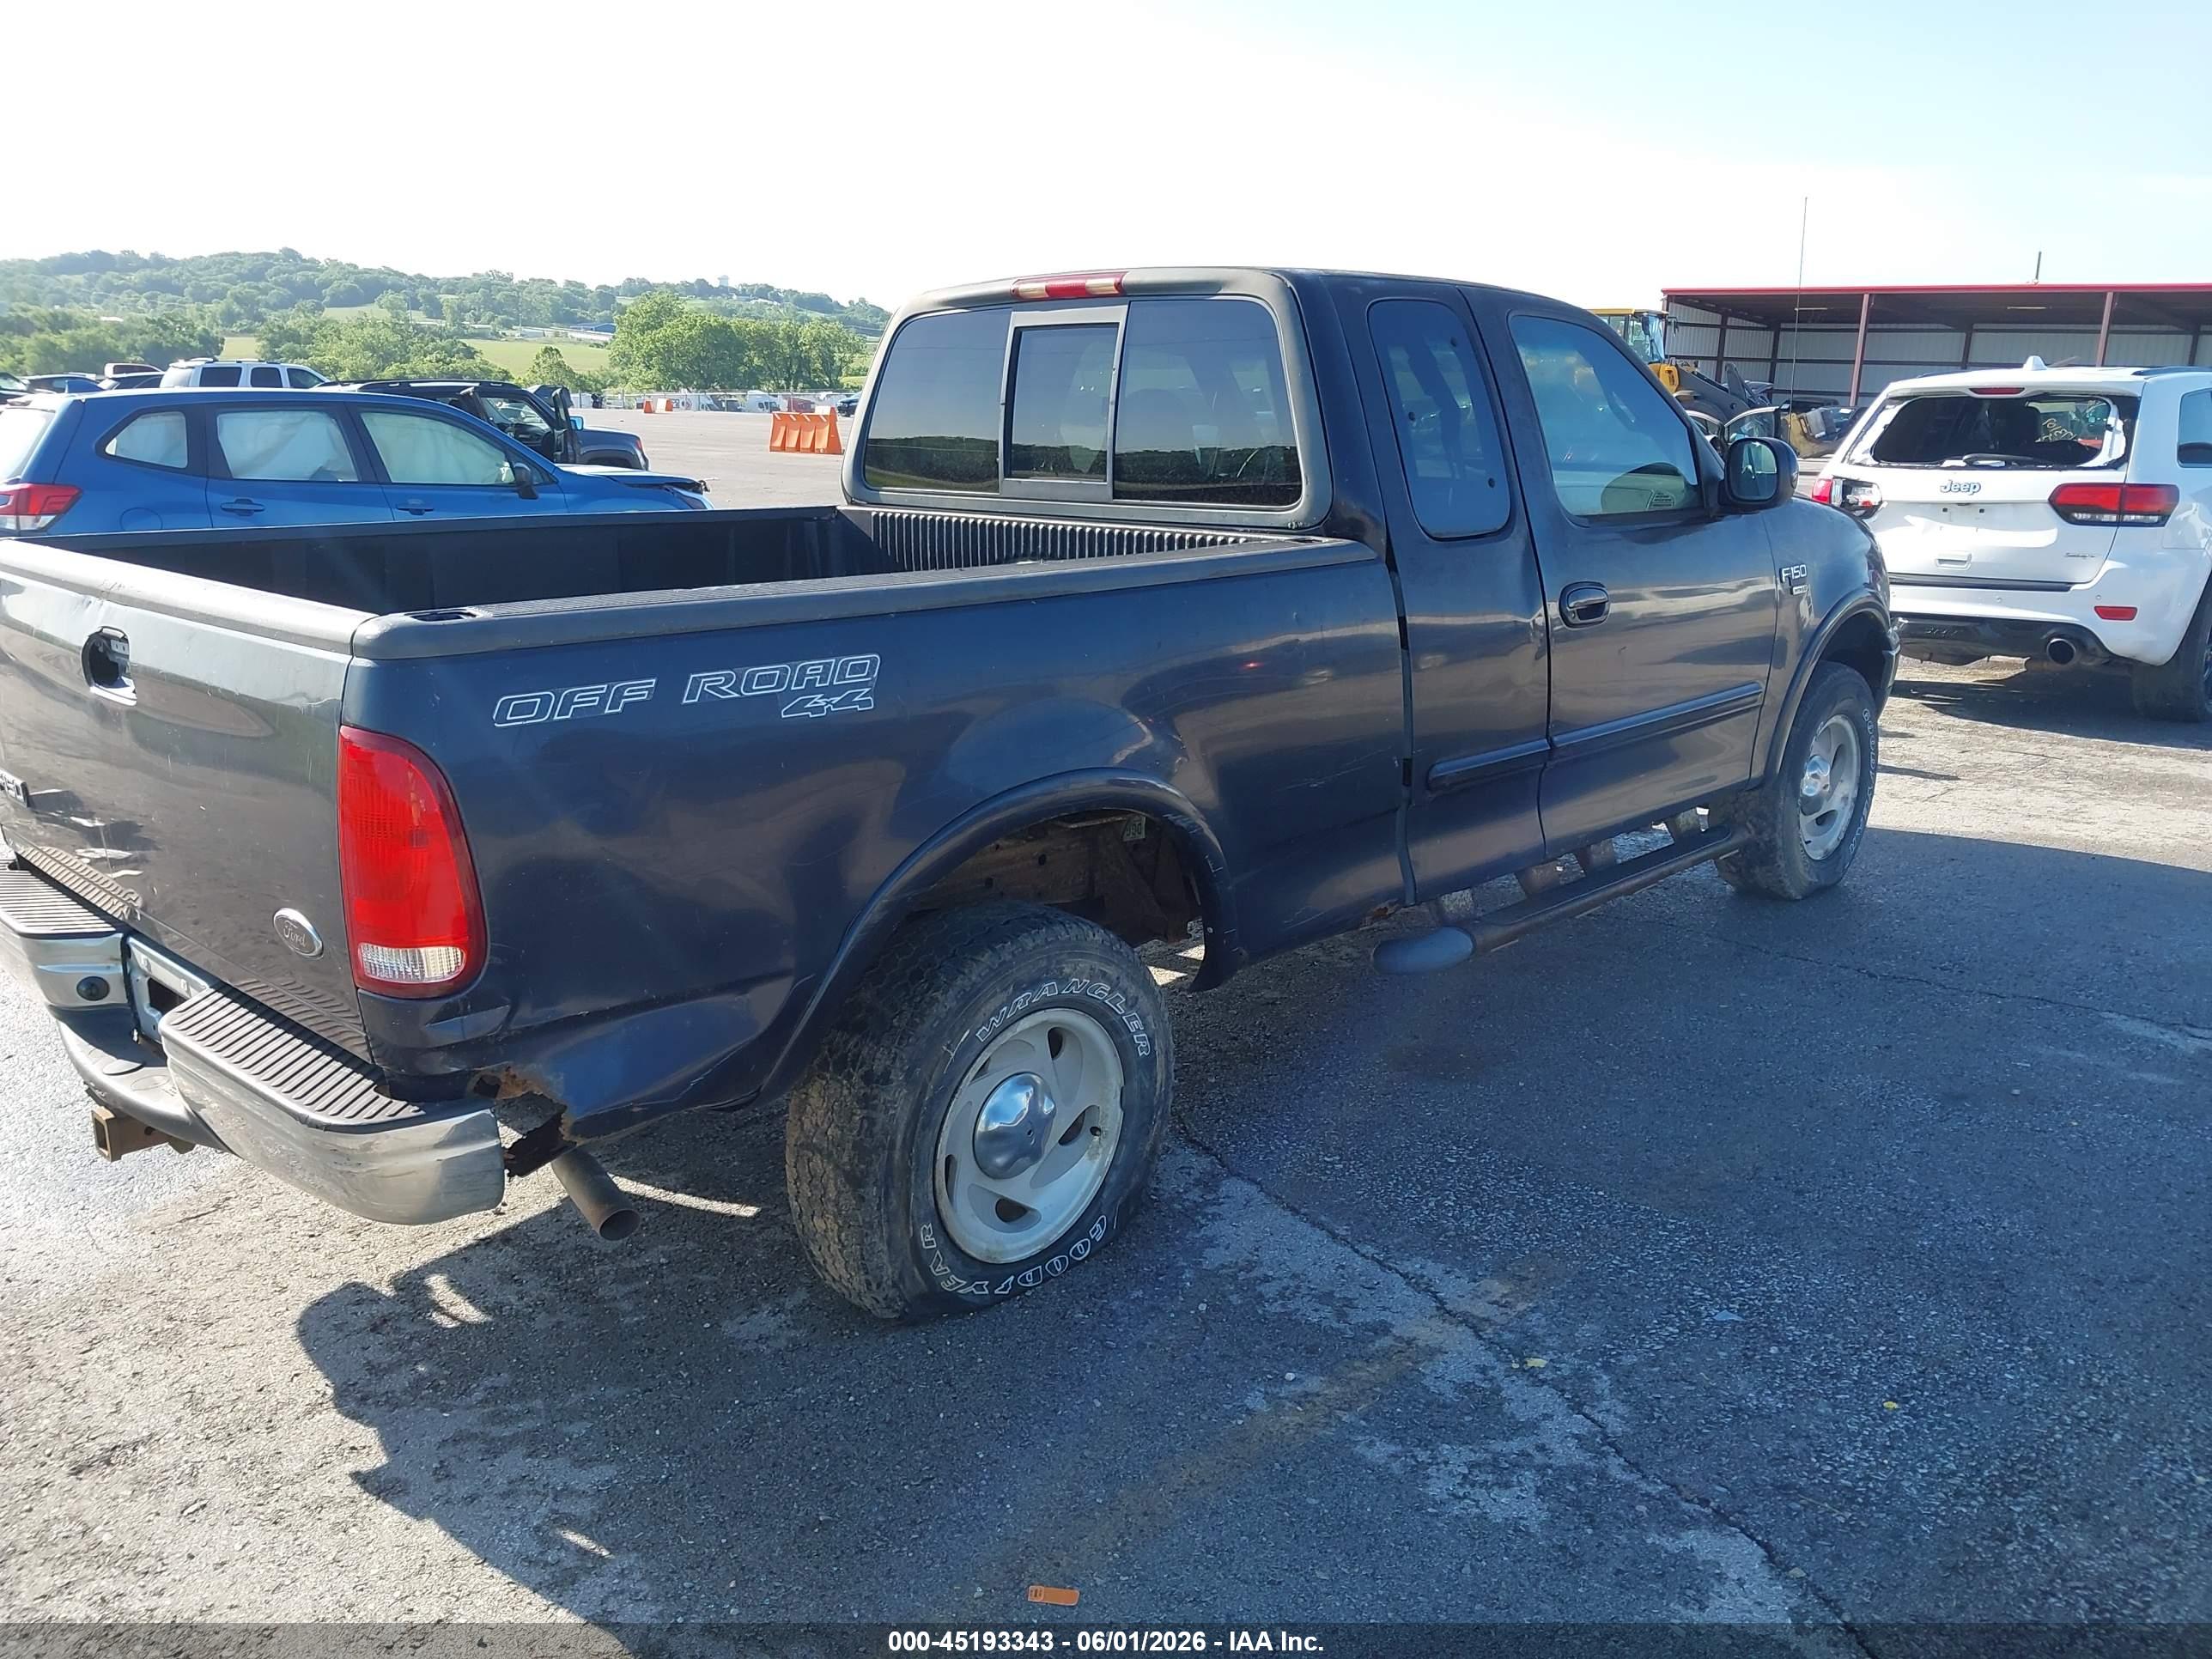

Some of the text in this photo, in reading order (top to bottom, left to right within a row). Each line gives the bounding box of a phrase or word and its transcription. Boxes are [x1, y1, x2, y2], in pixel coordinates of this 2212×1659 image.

[1940, 479, 1981, 495] Jeep
[492, 653, 881, 727] OFF ROAD
[975, 977, 1152, 1058] WRANGLER
[920, 1214, 1107, 1295] GOODYEAR
